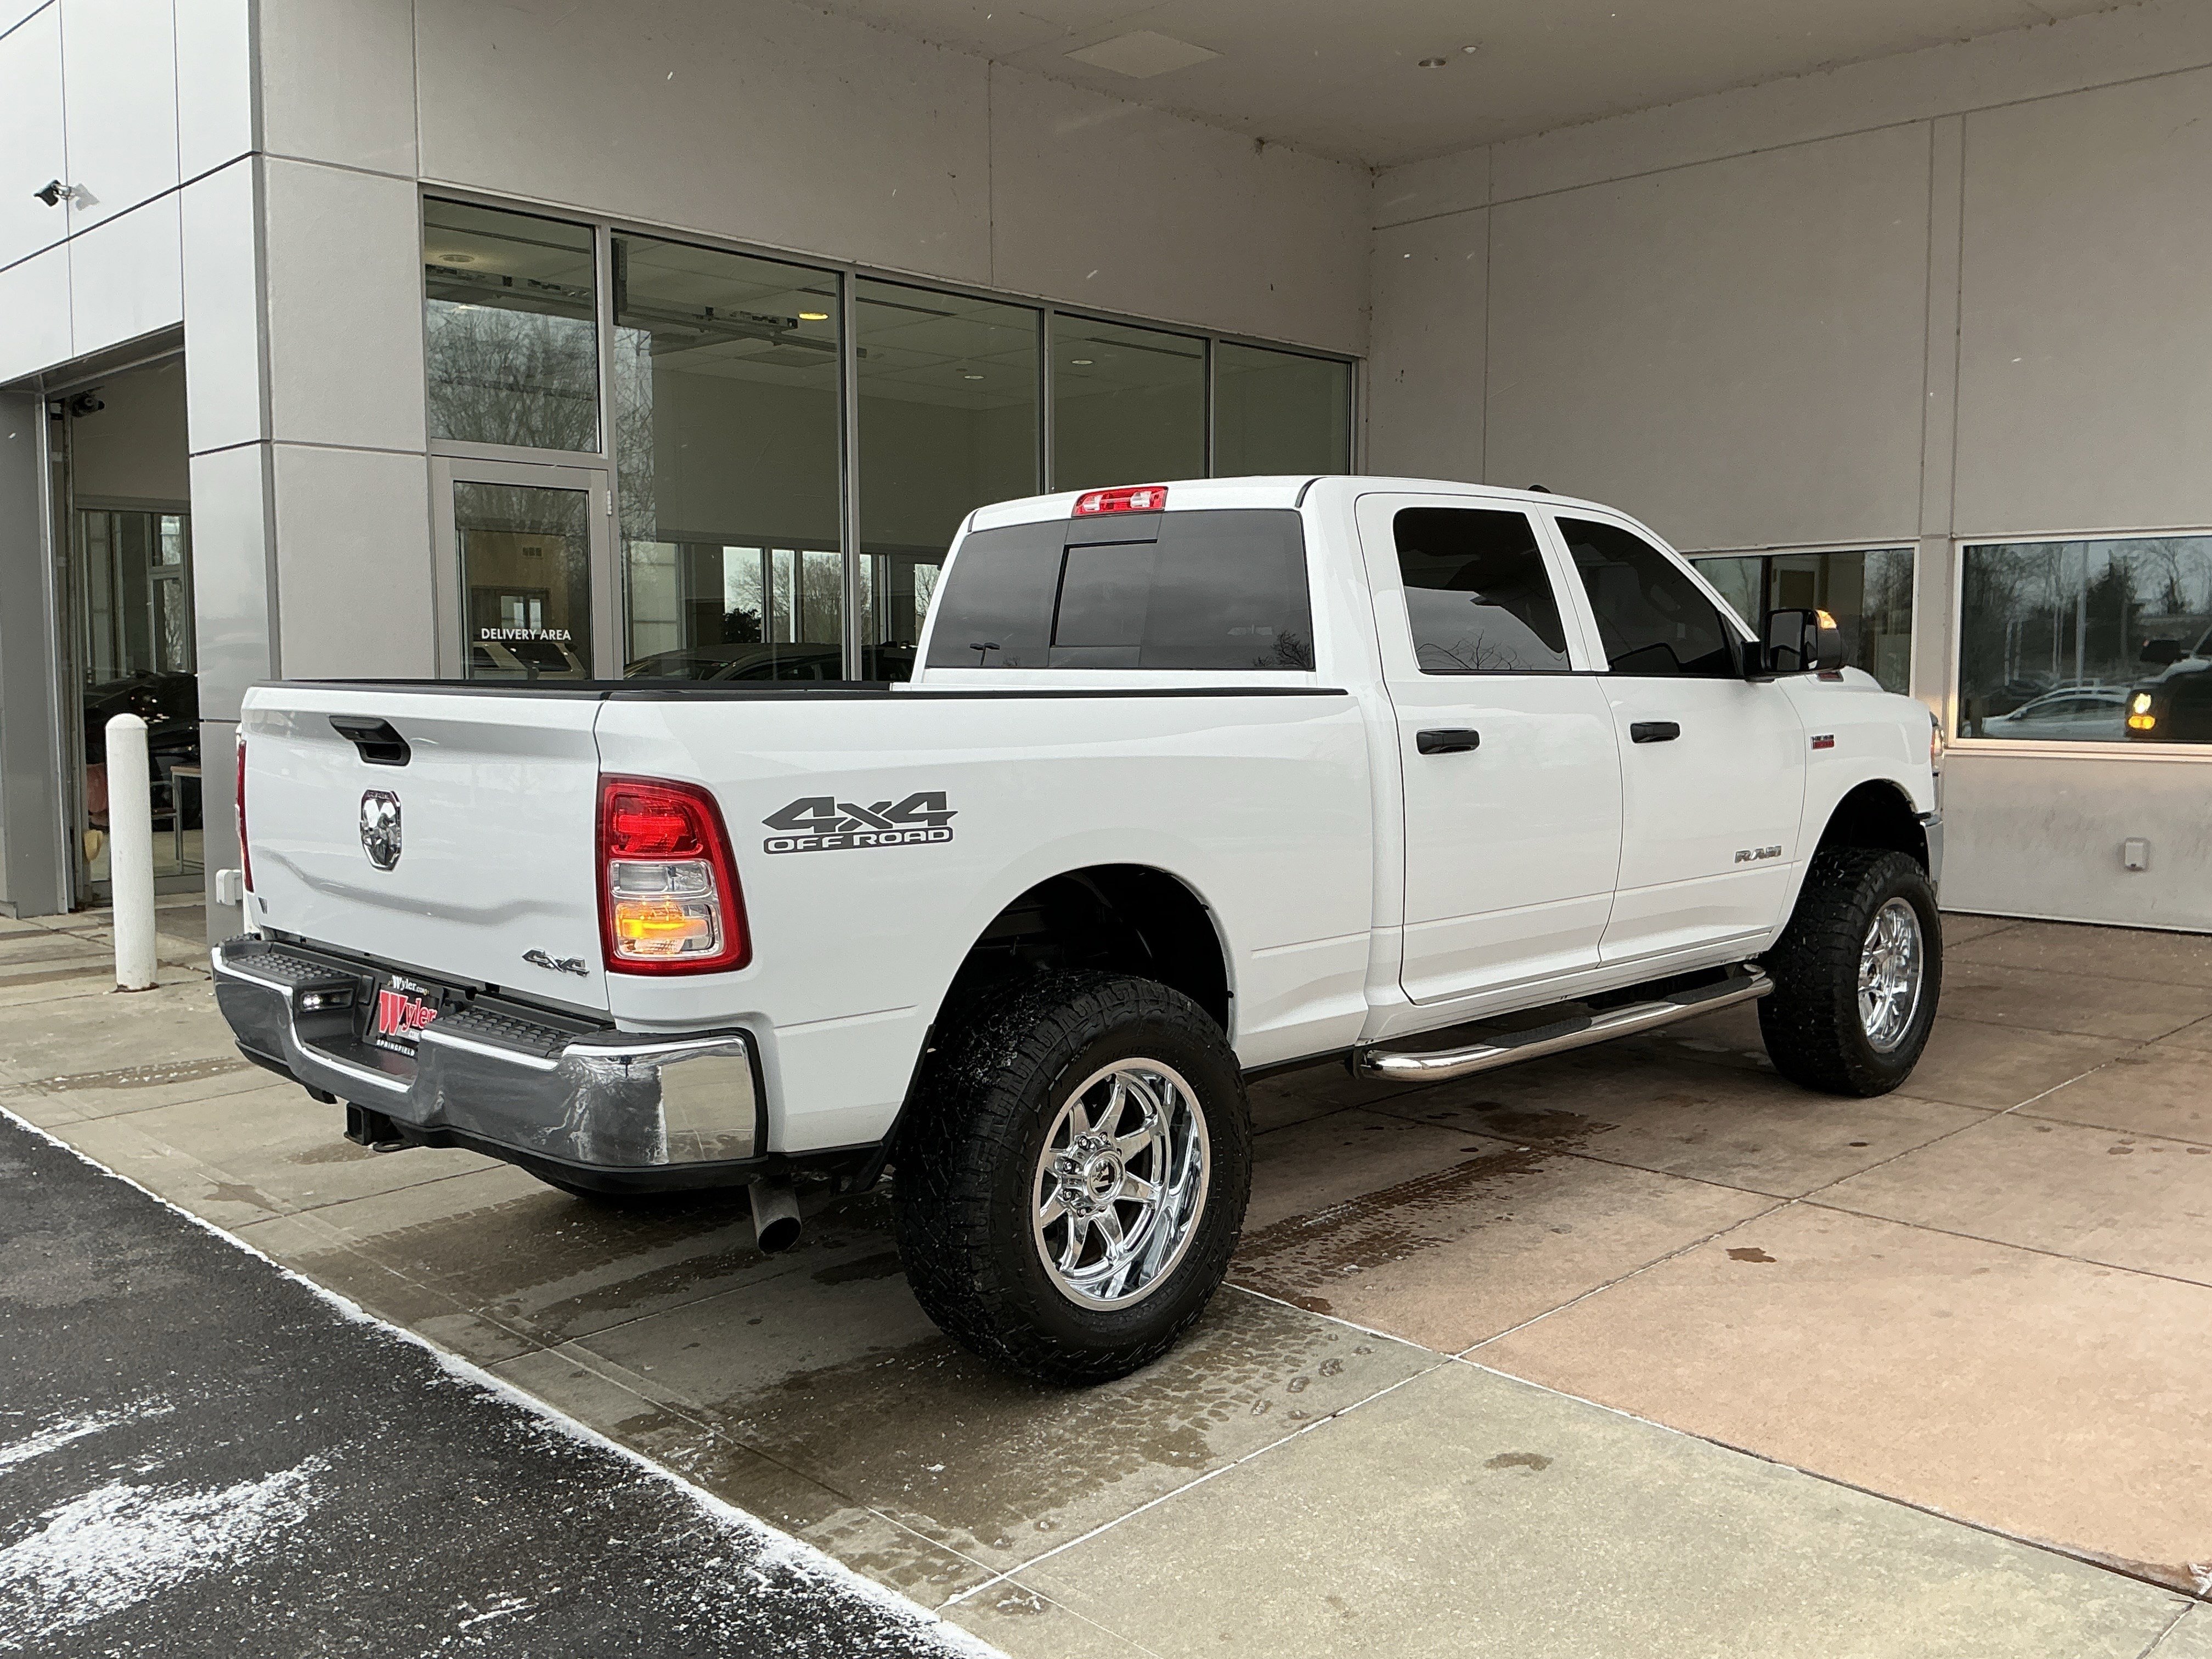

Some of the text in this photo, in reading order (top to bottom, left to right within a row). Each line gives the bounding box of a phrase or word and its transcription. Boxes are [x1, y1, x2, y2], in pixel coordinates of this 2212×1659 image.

[481, 628, 571, 640] DELIVERY AREA
[768, 828, 950, 851] OFF ROAD
[1734, 845, 1781, 863] RAM
[379, 989, 438, 1036] Wyler
[376, 1039, 415, 1056] SPRINGFIELD
